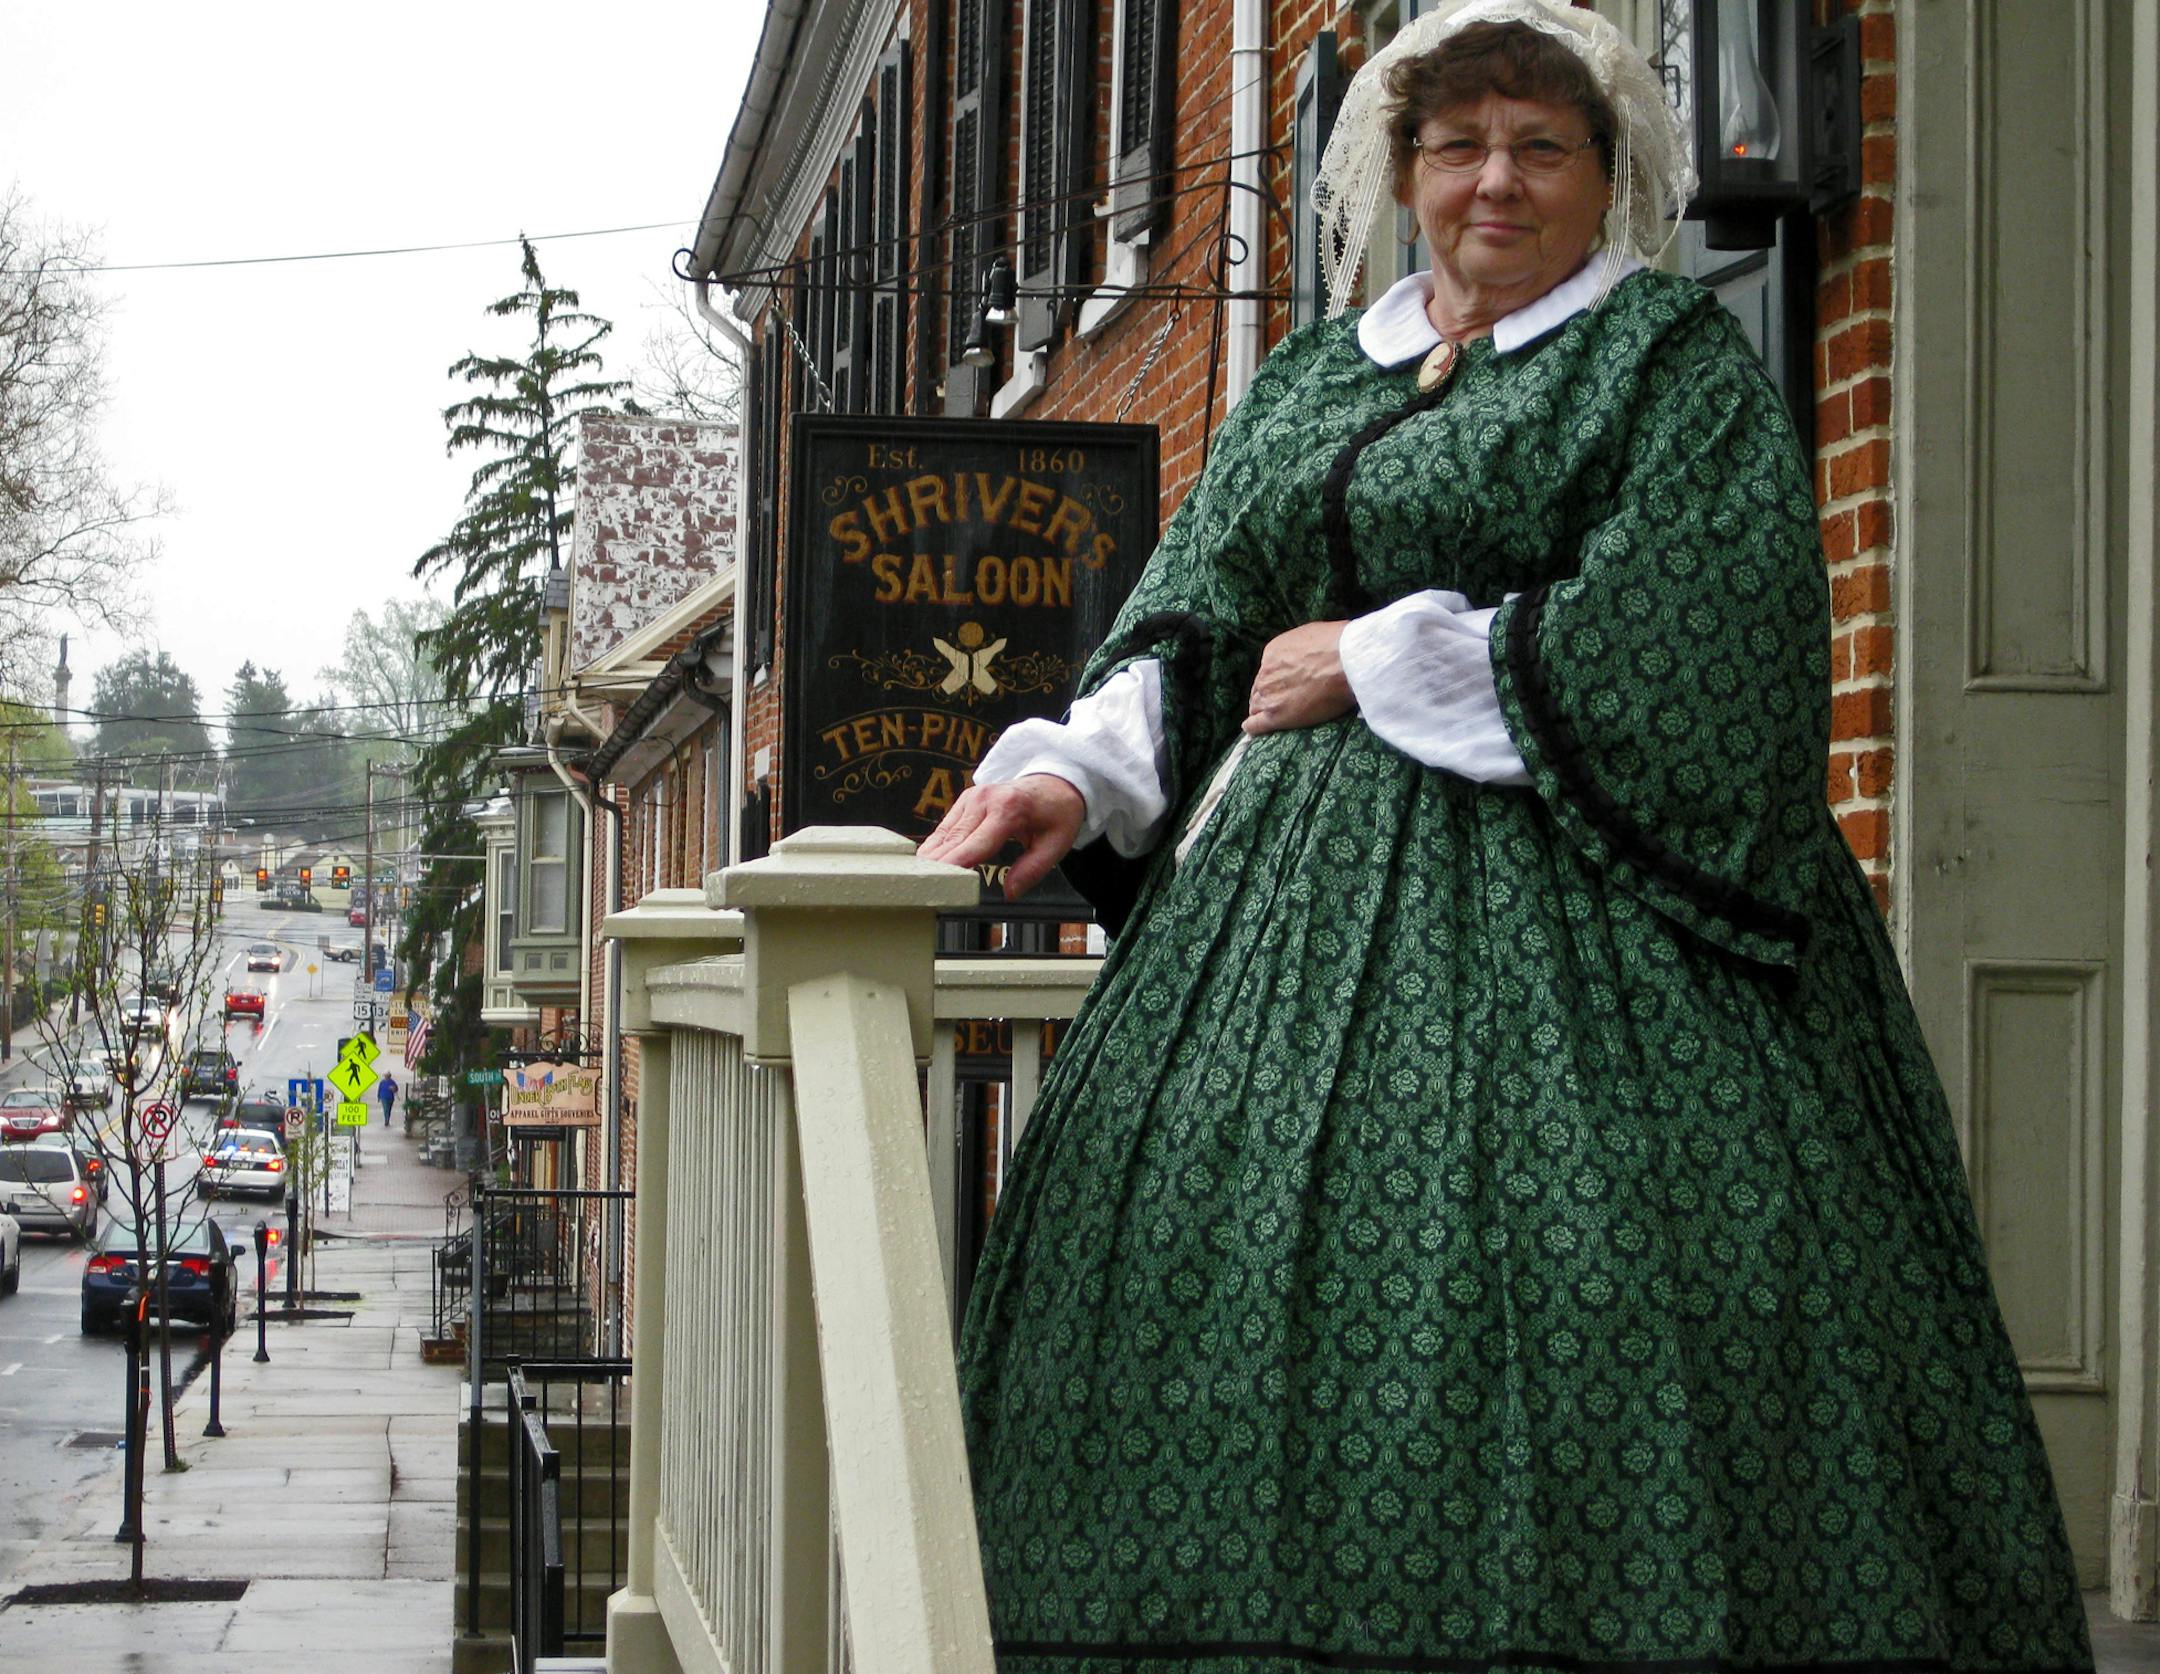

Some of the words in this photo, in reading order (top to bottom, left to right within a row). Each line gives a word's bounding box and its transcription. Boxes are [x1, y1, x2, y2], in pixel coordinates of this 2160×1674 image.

[867, 443, 924, 470] Est.
[1018, 447, 1085, 474] 1860
[871, 553, 1075, 609] SALOON
[357, 1006, 368, 1016] 15
[469, 1071, 494, 1083] SOUTH
[344, 1106, 360, 1114] 100
[510, 1109, 539, 1119] APPAREL
[560, 1109, 594, 1119] SOUVENIRS
[342, 1115, 362, 1123] FEET
